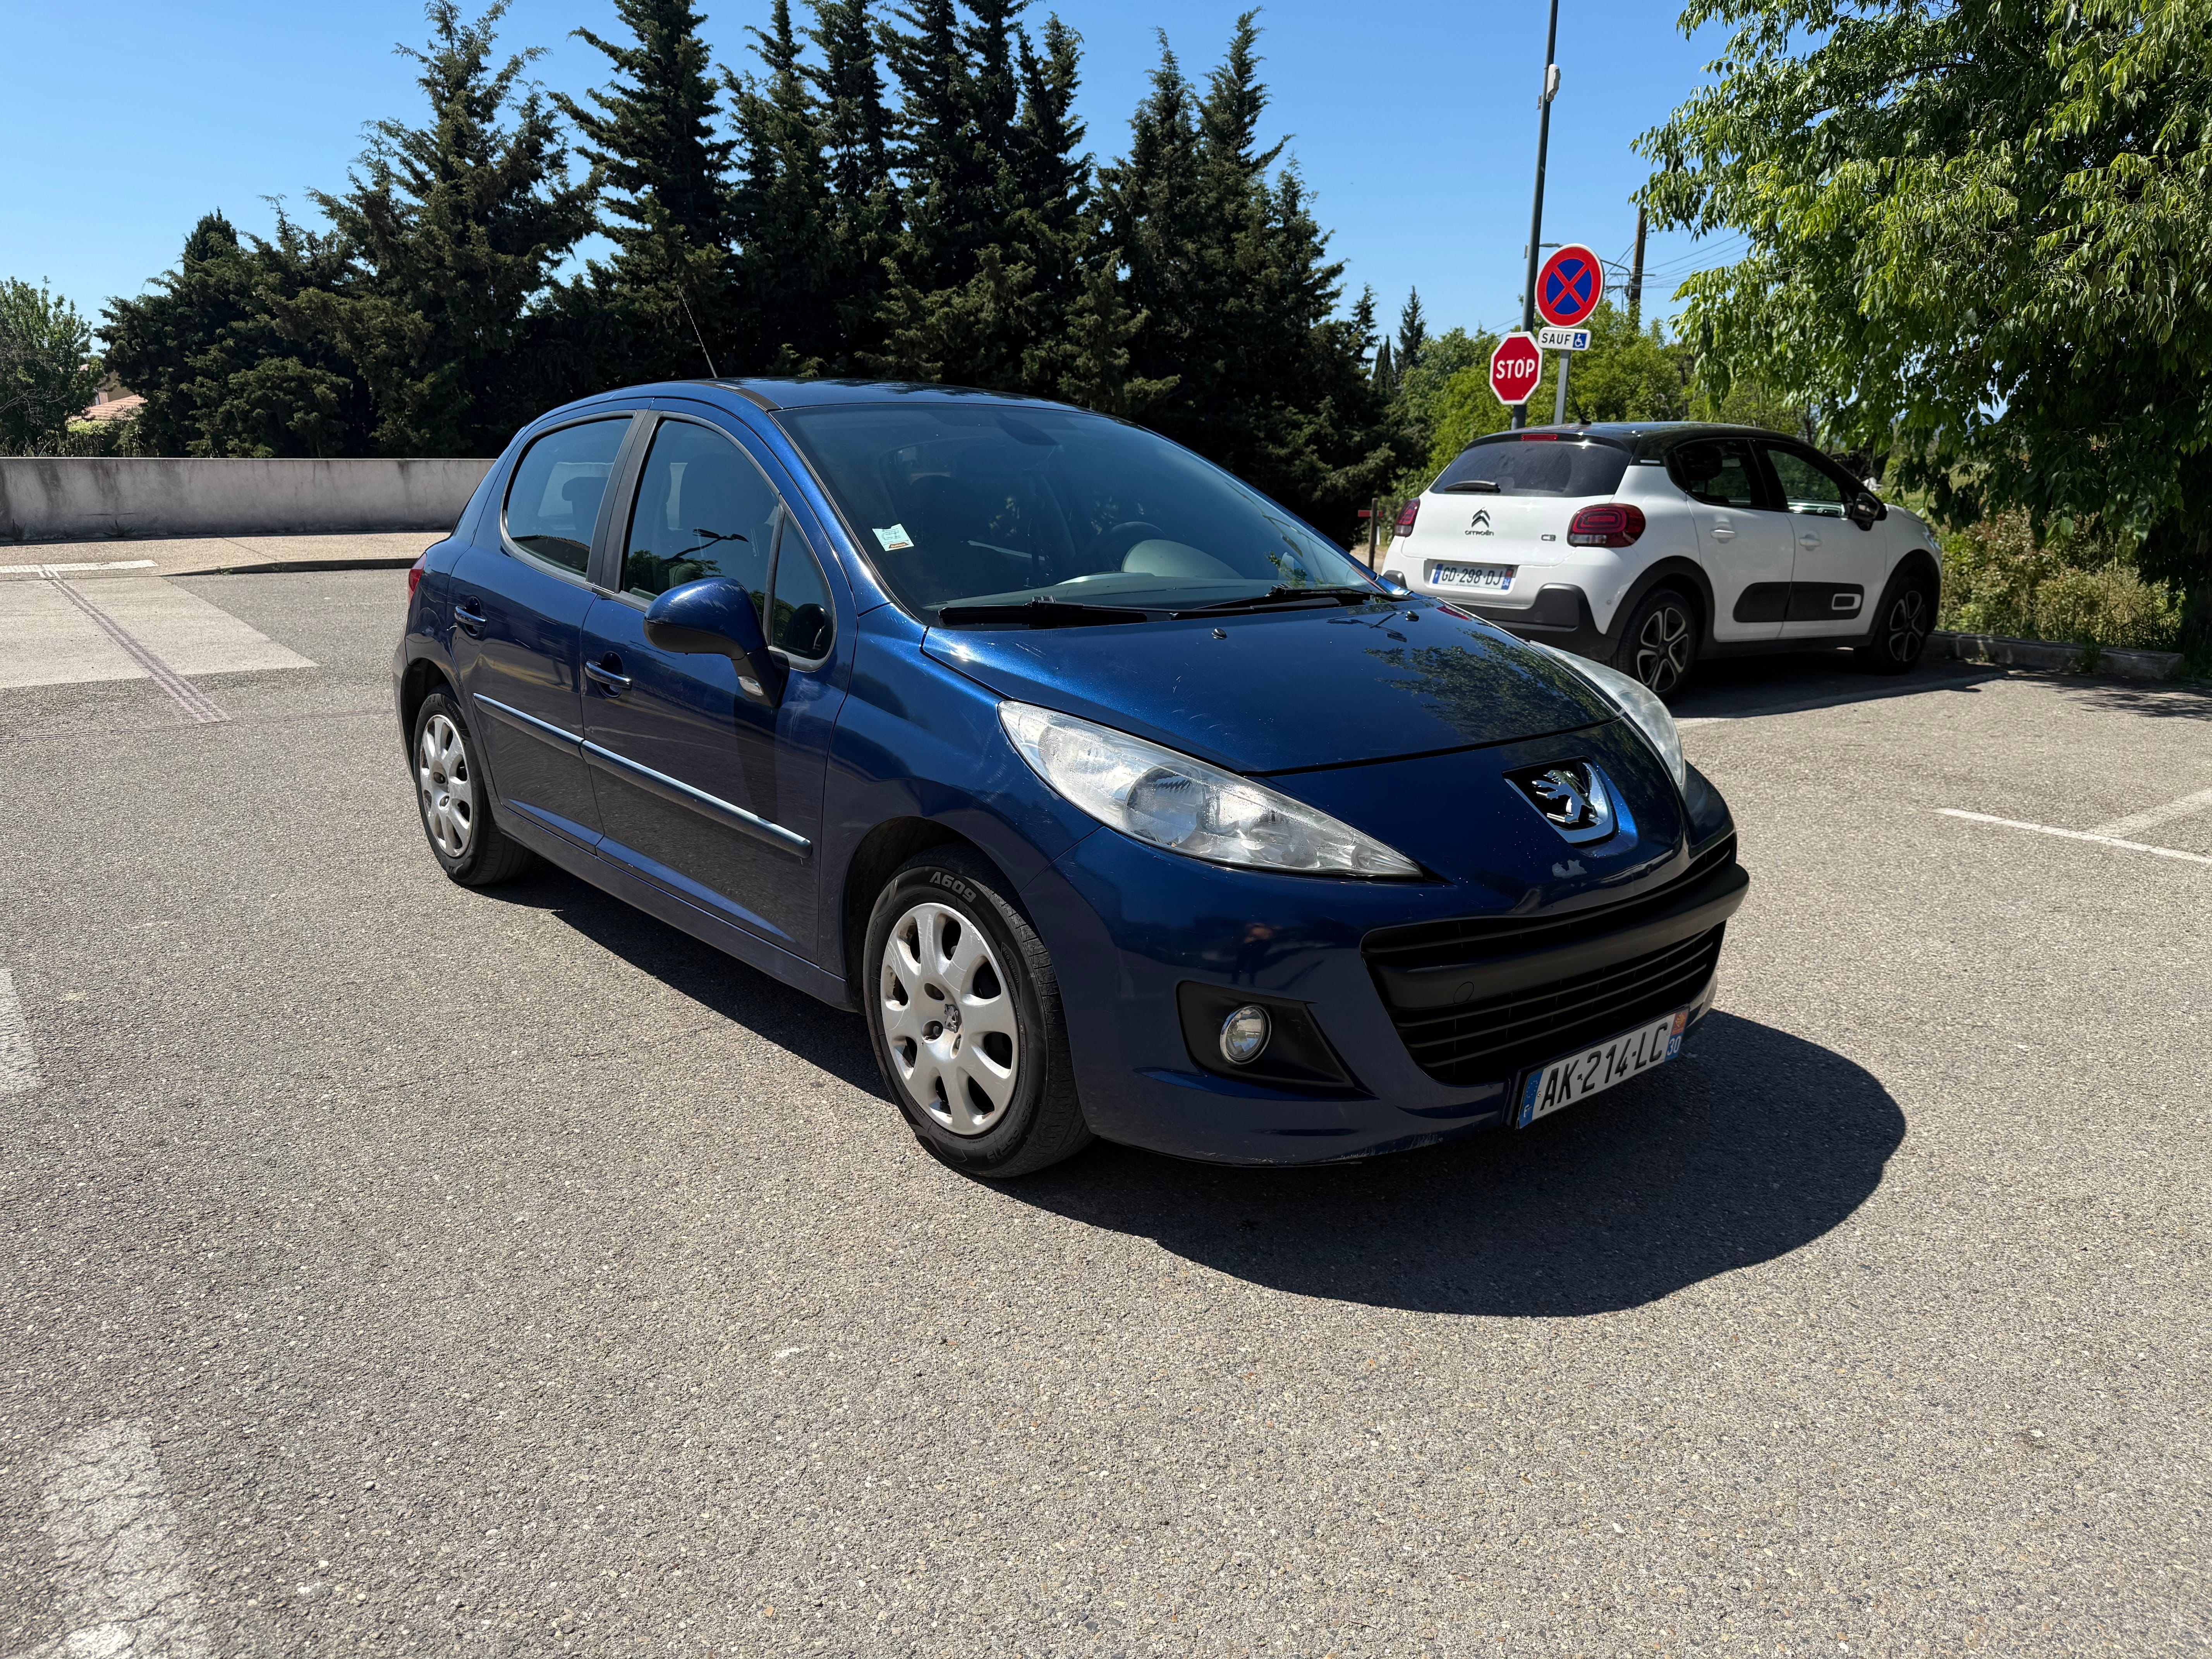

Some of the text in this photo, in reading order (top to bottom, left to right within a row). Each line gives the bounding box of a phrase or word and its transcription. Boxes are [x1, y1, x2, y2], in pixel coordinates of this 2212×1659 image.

[1541, 333, 1571, 345] SAUF
[1496, 359, 1535, 380] STOP
[1442, 567, 1503, 585] GD-298-DJ
[929, 871, 976, 903] A609
[1523, 1022, 1681, 1118] F AK-214-LC 30
